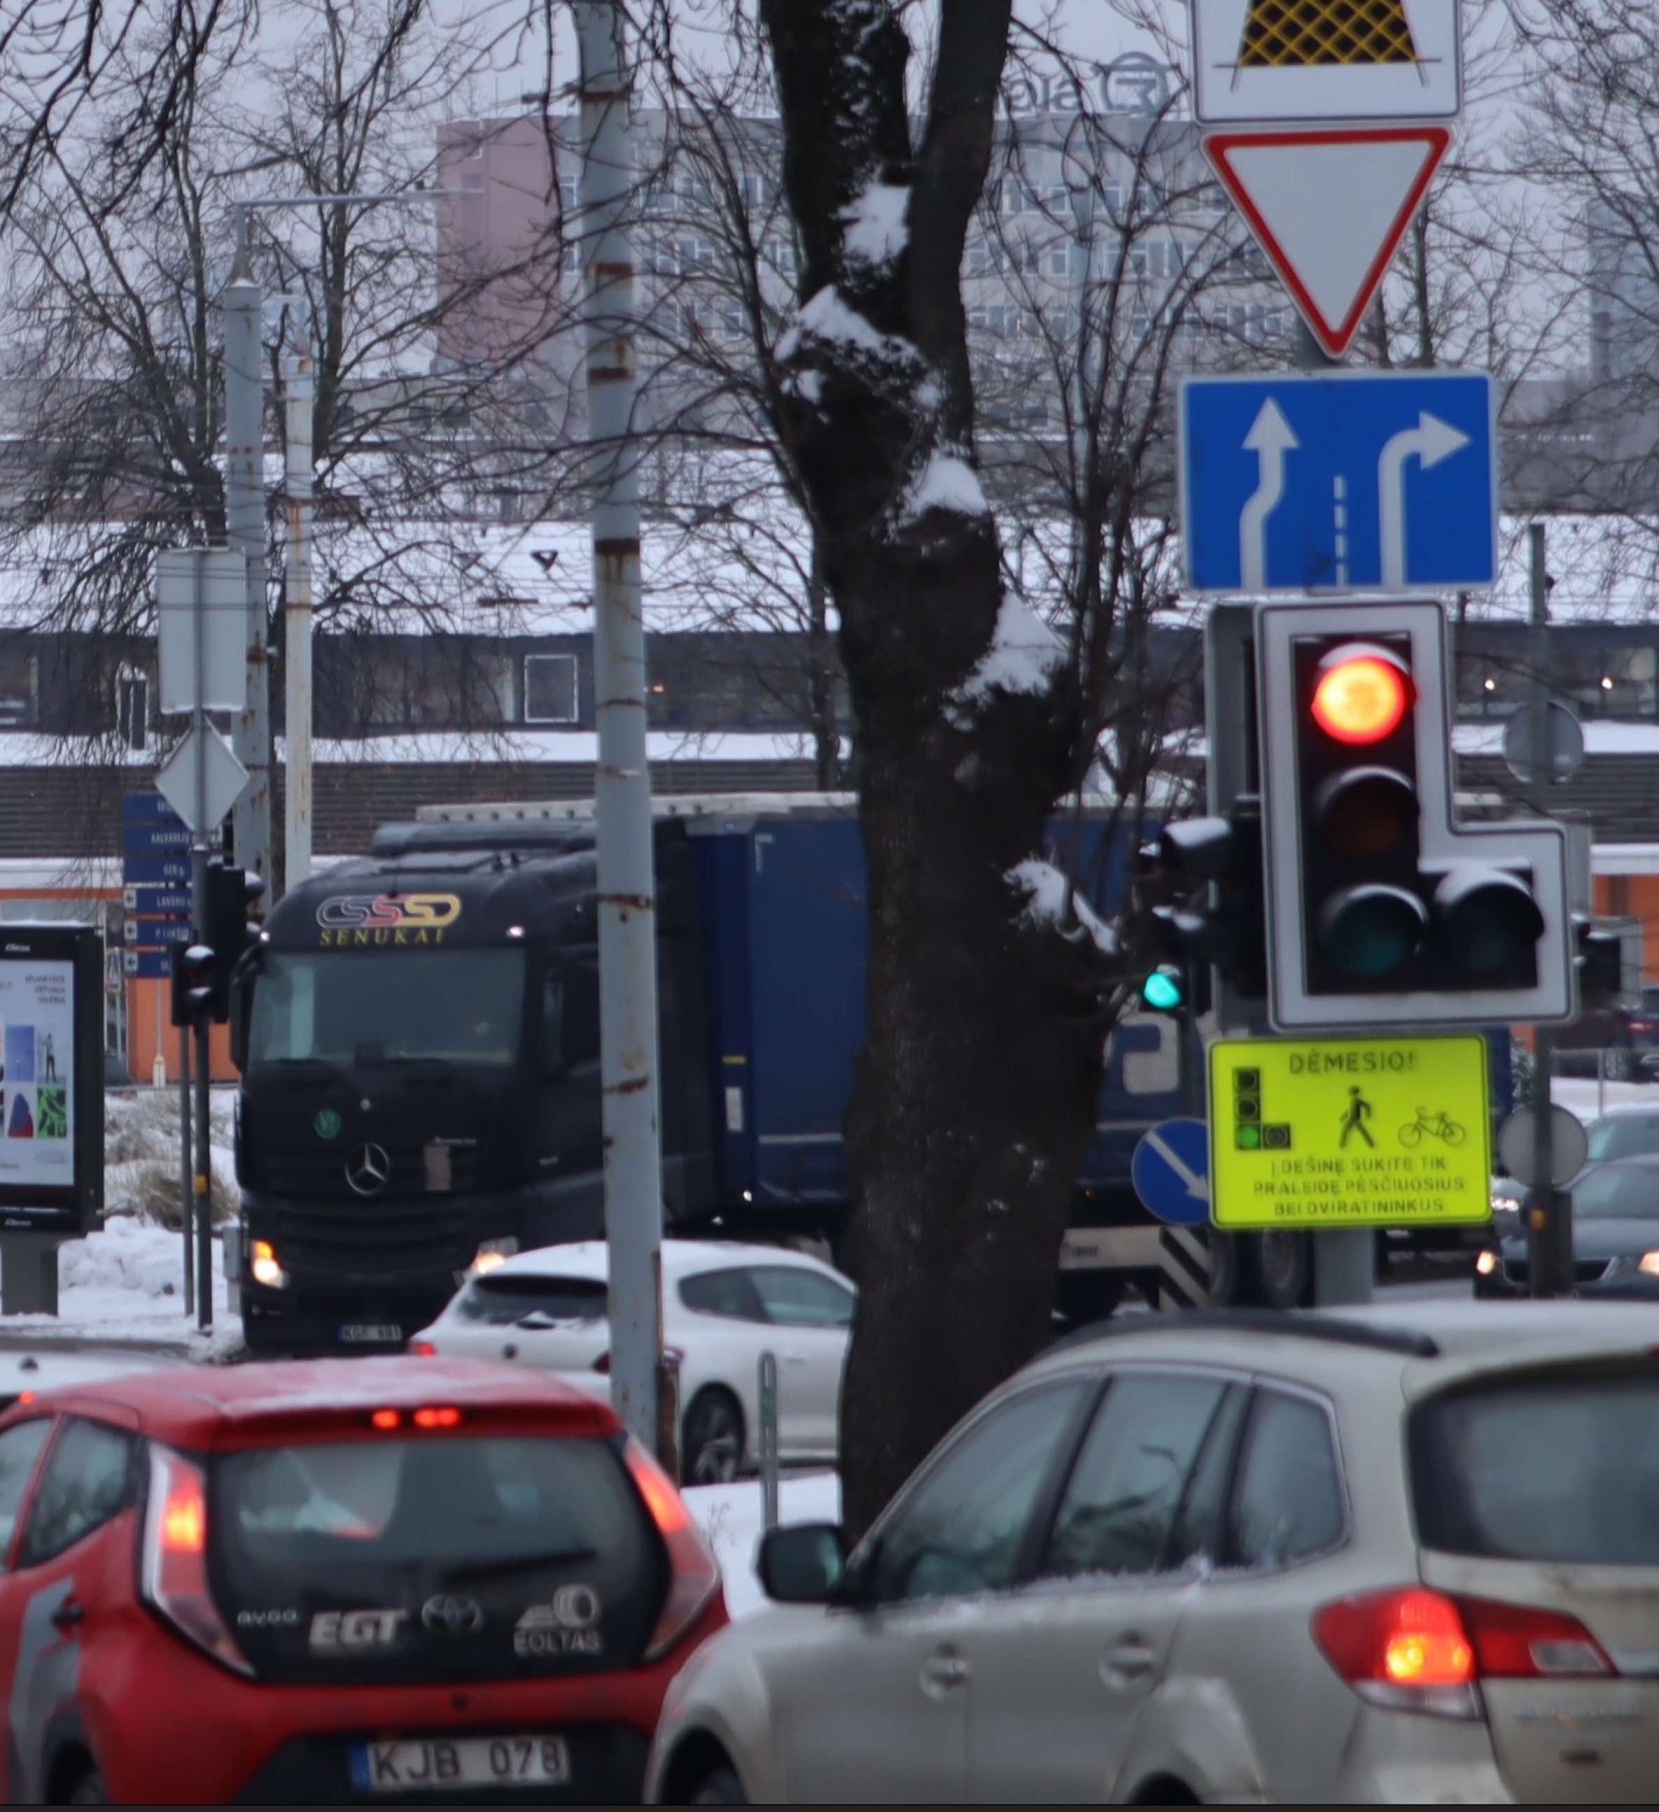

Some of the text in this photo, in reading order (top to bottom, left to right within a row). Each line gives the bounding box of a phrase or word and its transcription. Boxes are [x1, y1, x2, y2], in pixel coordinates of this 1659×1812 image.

[319, 928, 445, 946] SENUKAI
[1289, 1049, 1418, 1074] DĖMESIO!
[1282, 1156, 1345, 1175] DEŠINĘ
[1350, 1156, 1413, 1172] SUKITE
[1420, 1156, 1446, 1170] TIK
[1275, 1198, 1444, 1216] BEI DVIRATININKUS
[309, 1608, 407, 1647] EGT
[514, 1629, 601, 1656] EOLTAS
[374, 1739, 563, 1783] KJB 078
